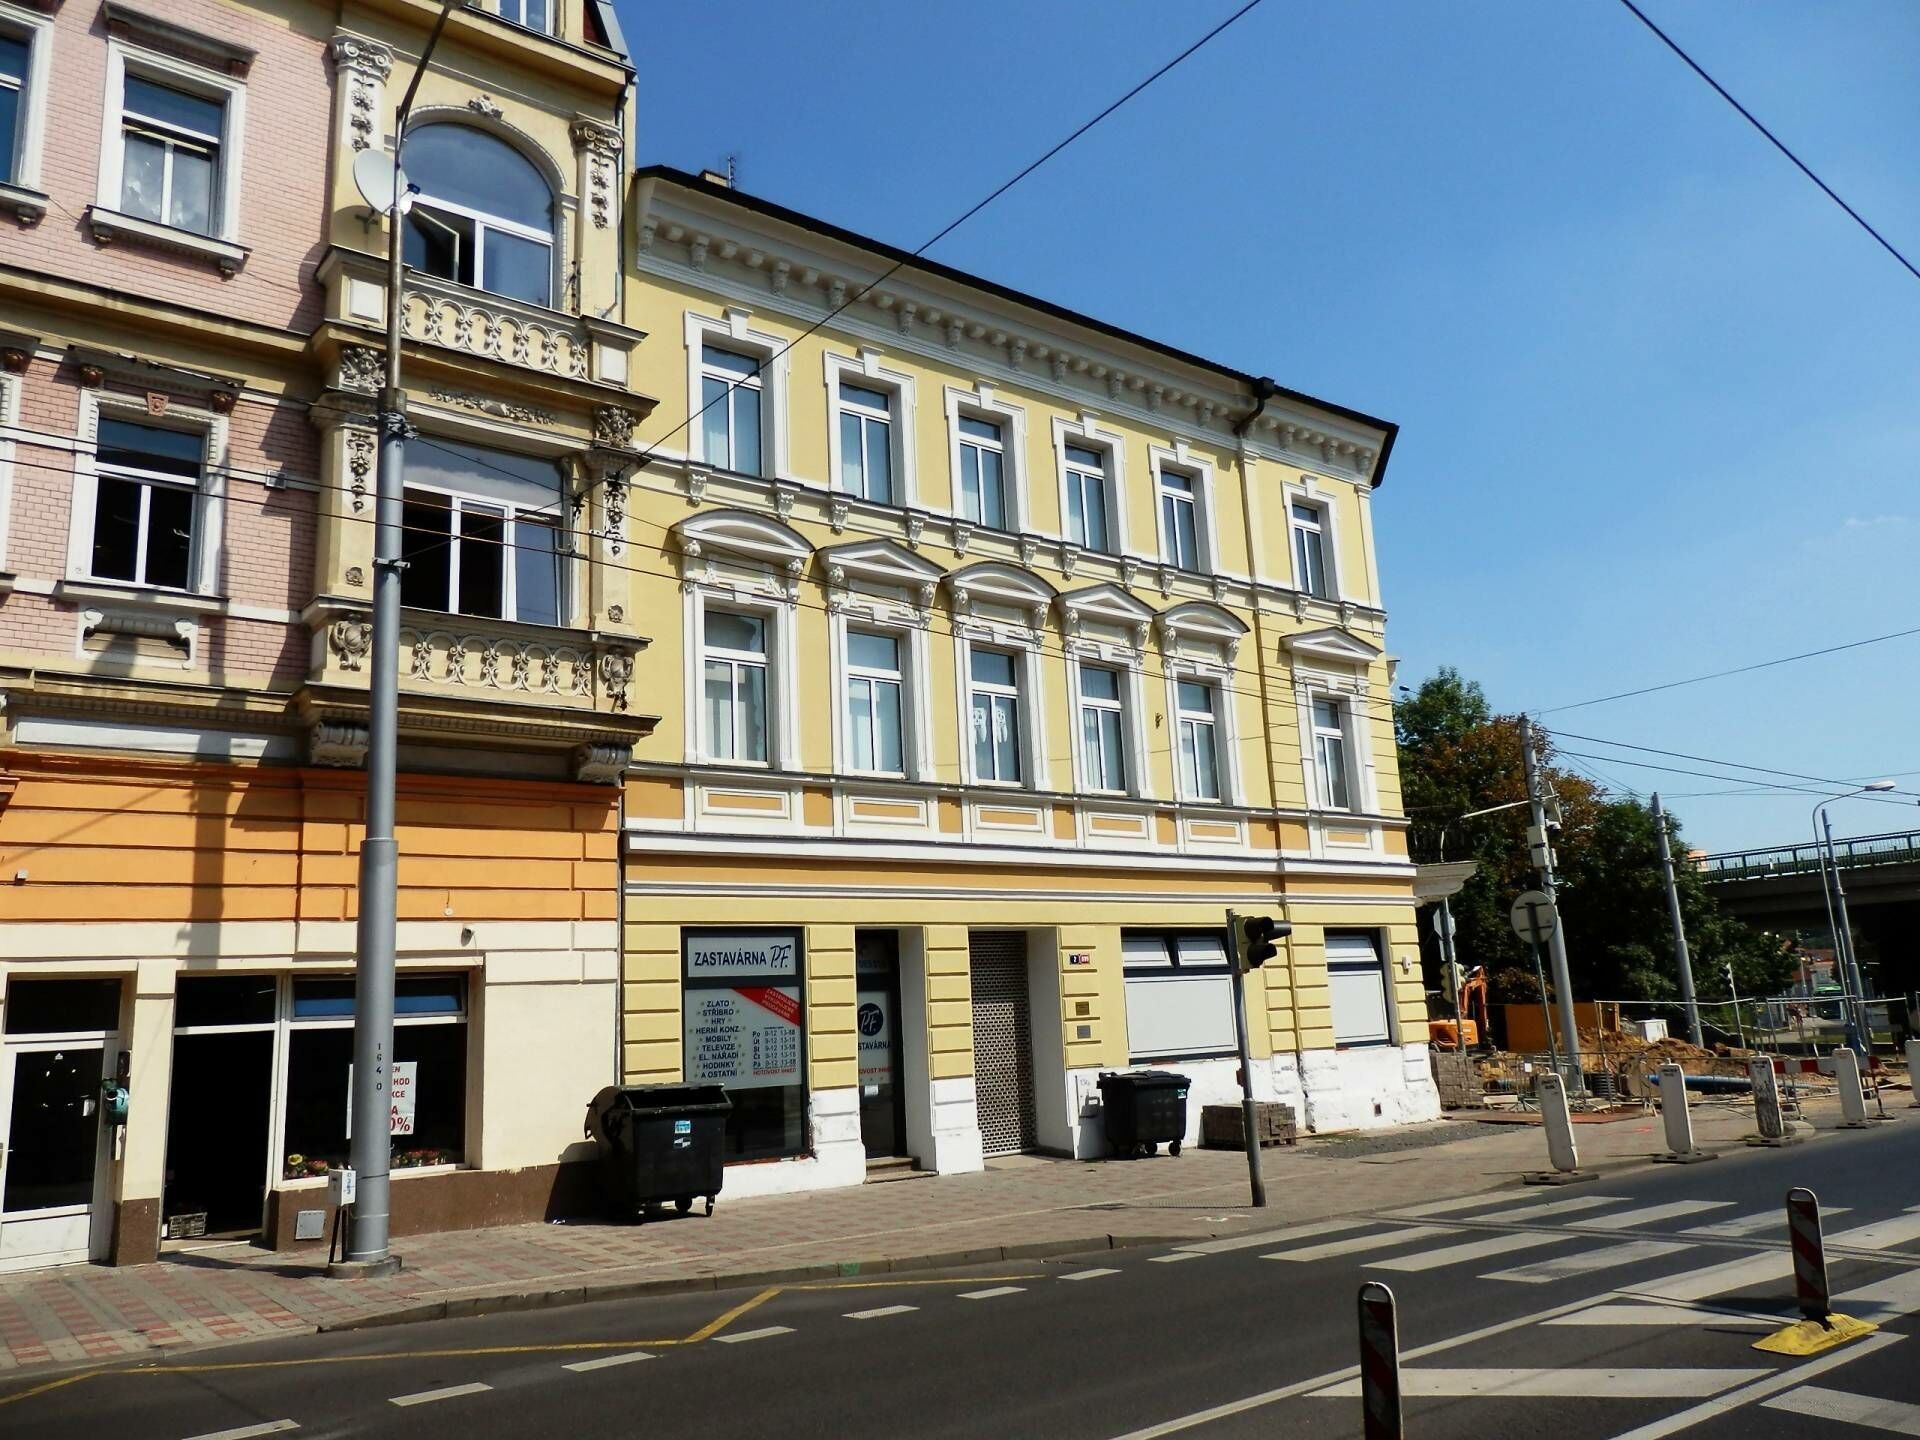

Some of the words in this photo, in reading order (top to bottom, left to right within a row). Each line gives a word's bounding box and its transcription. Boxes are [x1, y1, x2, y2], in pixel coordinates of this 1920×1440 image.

[695, 948, 766, 967] ZASTAVÁRNA
[702, 1007, 734, 1016] STŘÍBRO
[695, 1025, 718, 1034] HERNÍ
[705, 1035, 732, 1043] MOBILY
[702, 1043, 736, 1051] TELEVIZE
[858, 1040, 891, 1050] STAVÁRNA
[703, 1061, 735, 1069] HODINKY
[707, 1069, 738, 1078] OSTATNÍ
[393, 1078, 410, 1086] HOD
[391, 1105, 398, 1115] A
